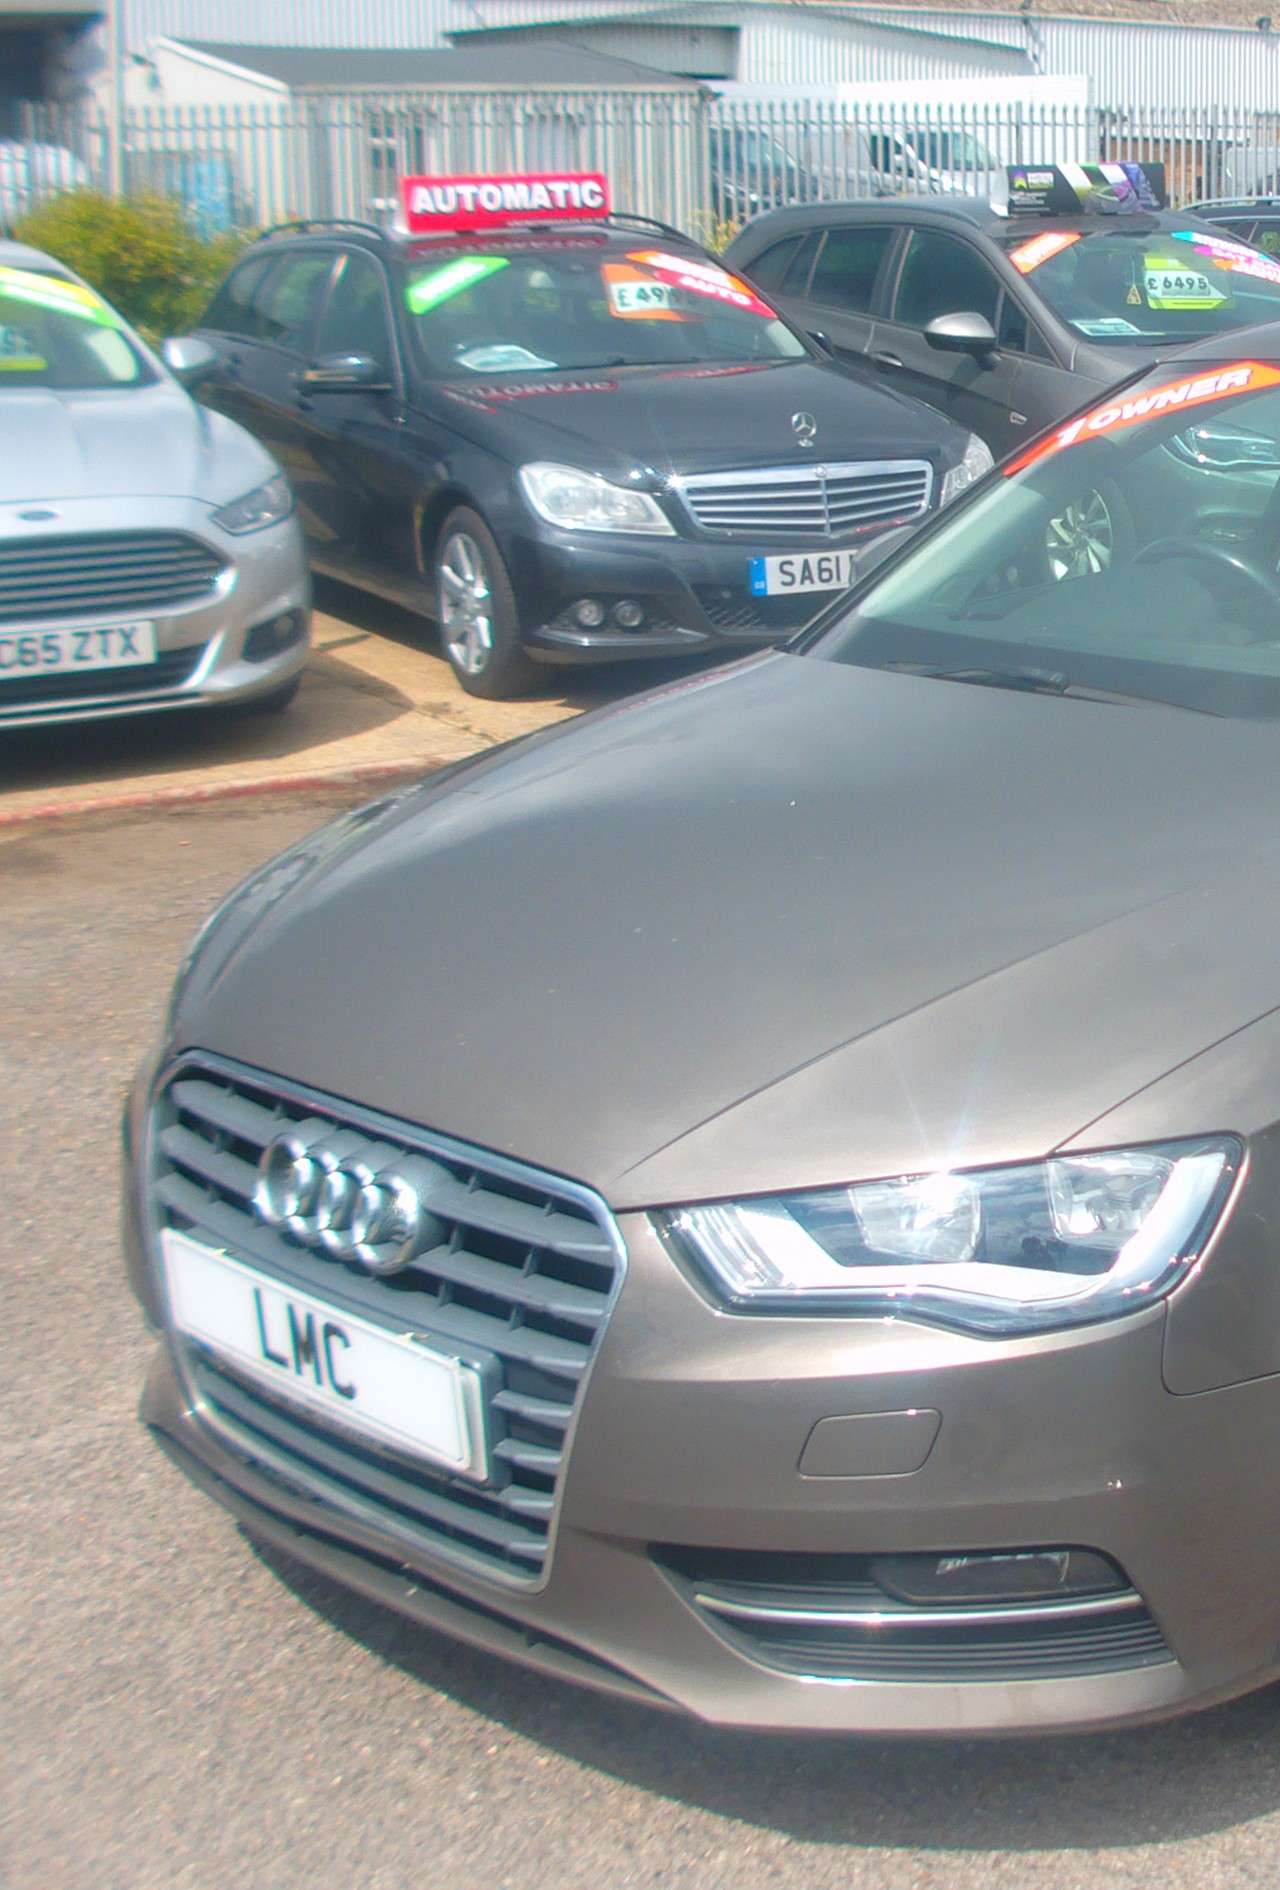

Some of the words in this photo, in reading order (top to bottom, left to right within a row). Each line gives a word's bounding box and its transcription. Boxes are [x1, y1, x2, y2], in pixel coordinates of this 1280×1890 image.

[411, 180, 605, 214] AUTOMATIC
[1054, 416, 1087, 448] 1
[1087, 367, 1252, 431] OWNER
[778, 555, 842, 587] SA61
[71, 627, 140, 662] ZTX
[253, 1287, 358, 1401] LMC
